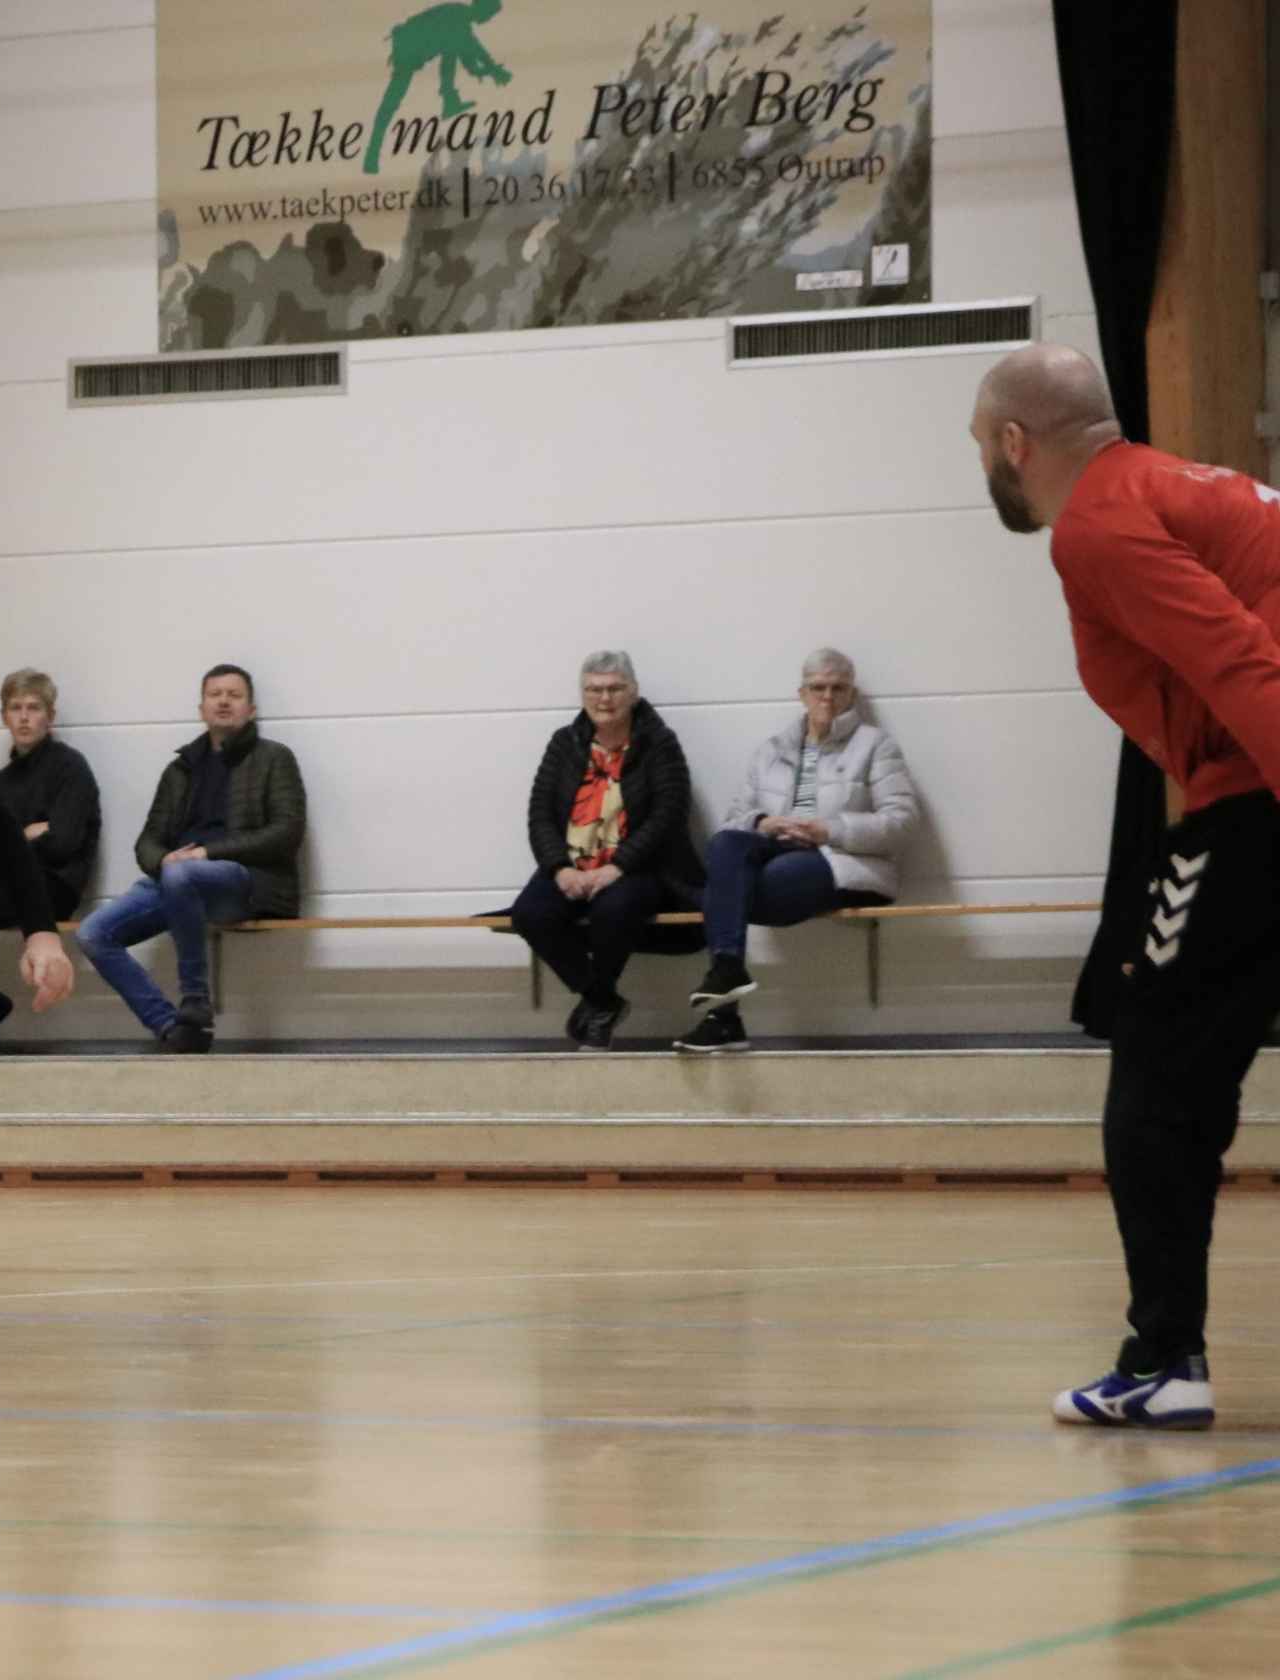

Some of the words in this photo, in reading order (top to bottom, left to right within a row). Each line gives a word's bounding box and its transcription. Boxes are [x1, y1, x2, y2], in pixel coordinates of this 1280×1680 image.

[582, 81, 727, 141] Peter
[742, 69, 885, 134] Berg
[484, 175, 519, 206] 20
[532, 171, 566, 201] 36
[578, 168, 609, 199] 17
[691, 155, 766, 188] 6855
